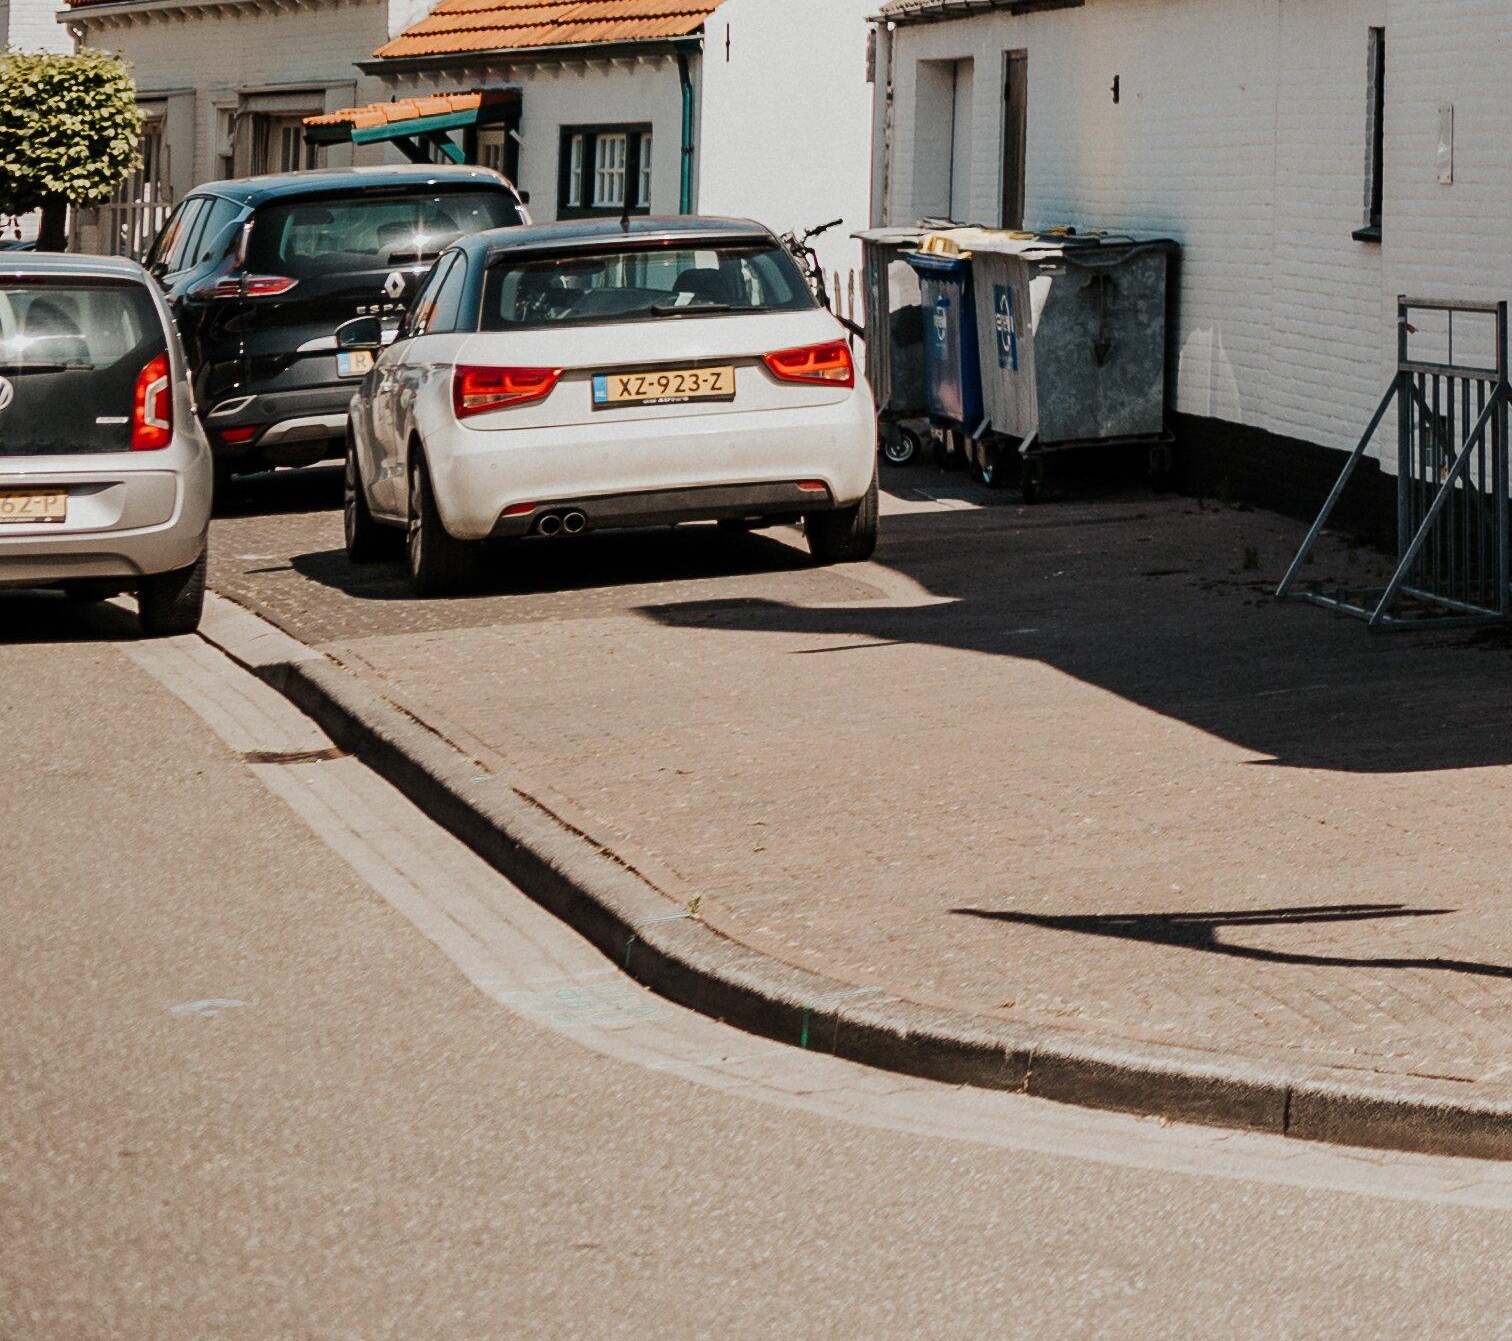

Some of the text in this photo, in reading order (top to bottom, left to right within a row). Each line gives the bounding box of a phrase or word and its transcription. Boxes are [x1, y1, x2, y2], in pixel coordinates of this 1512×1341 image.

[357, 304, 406, 315] ESPA
[619, 373, 722, 397] XZ-923-Z
[0, 496, 58, 513] 62-P
